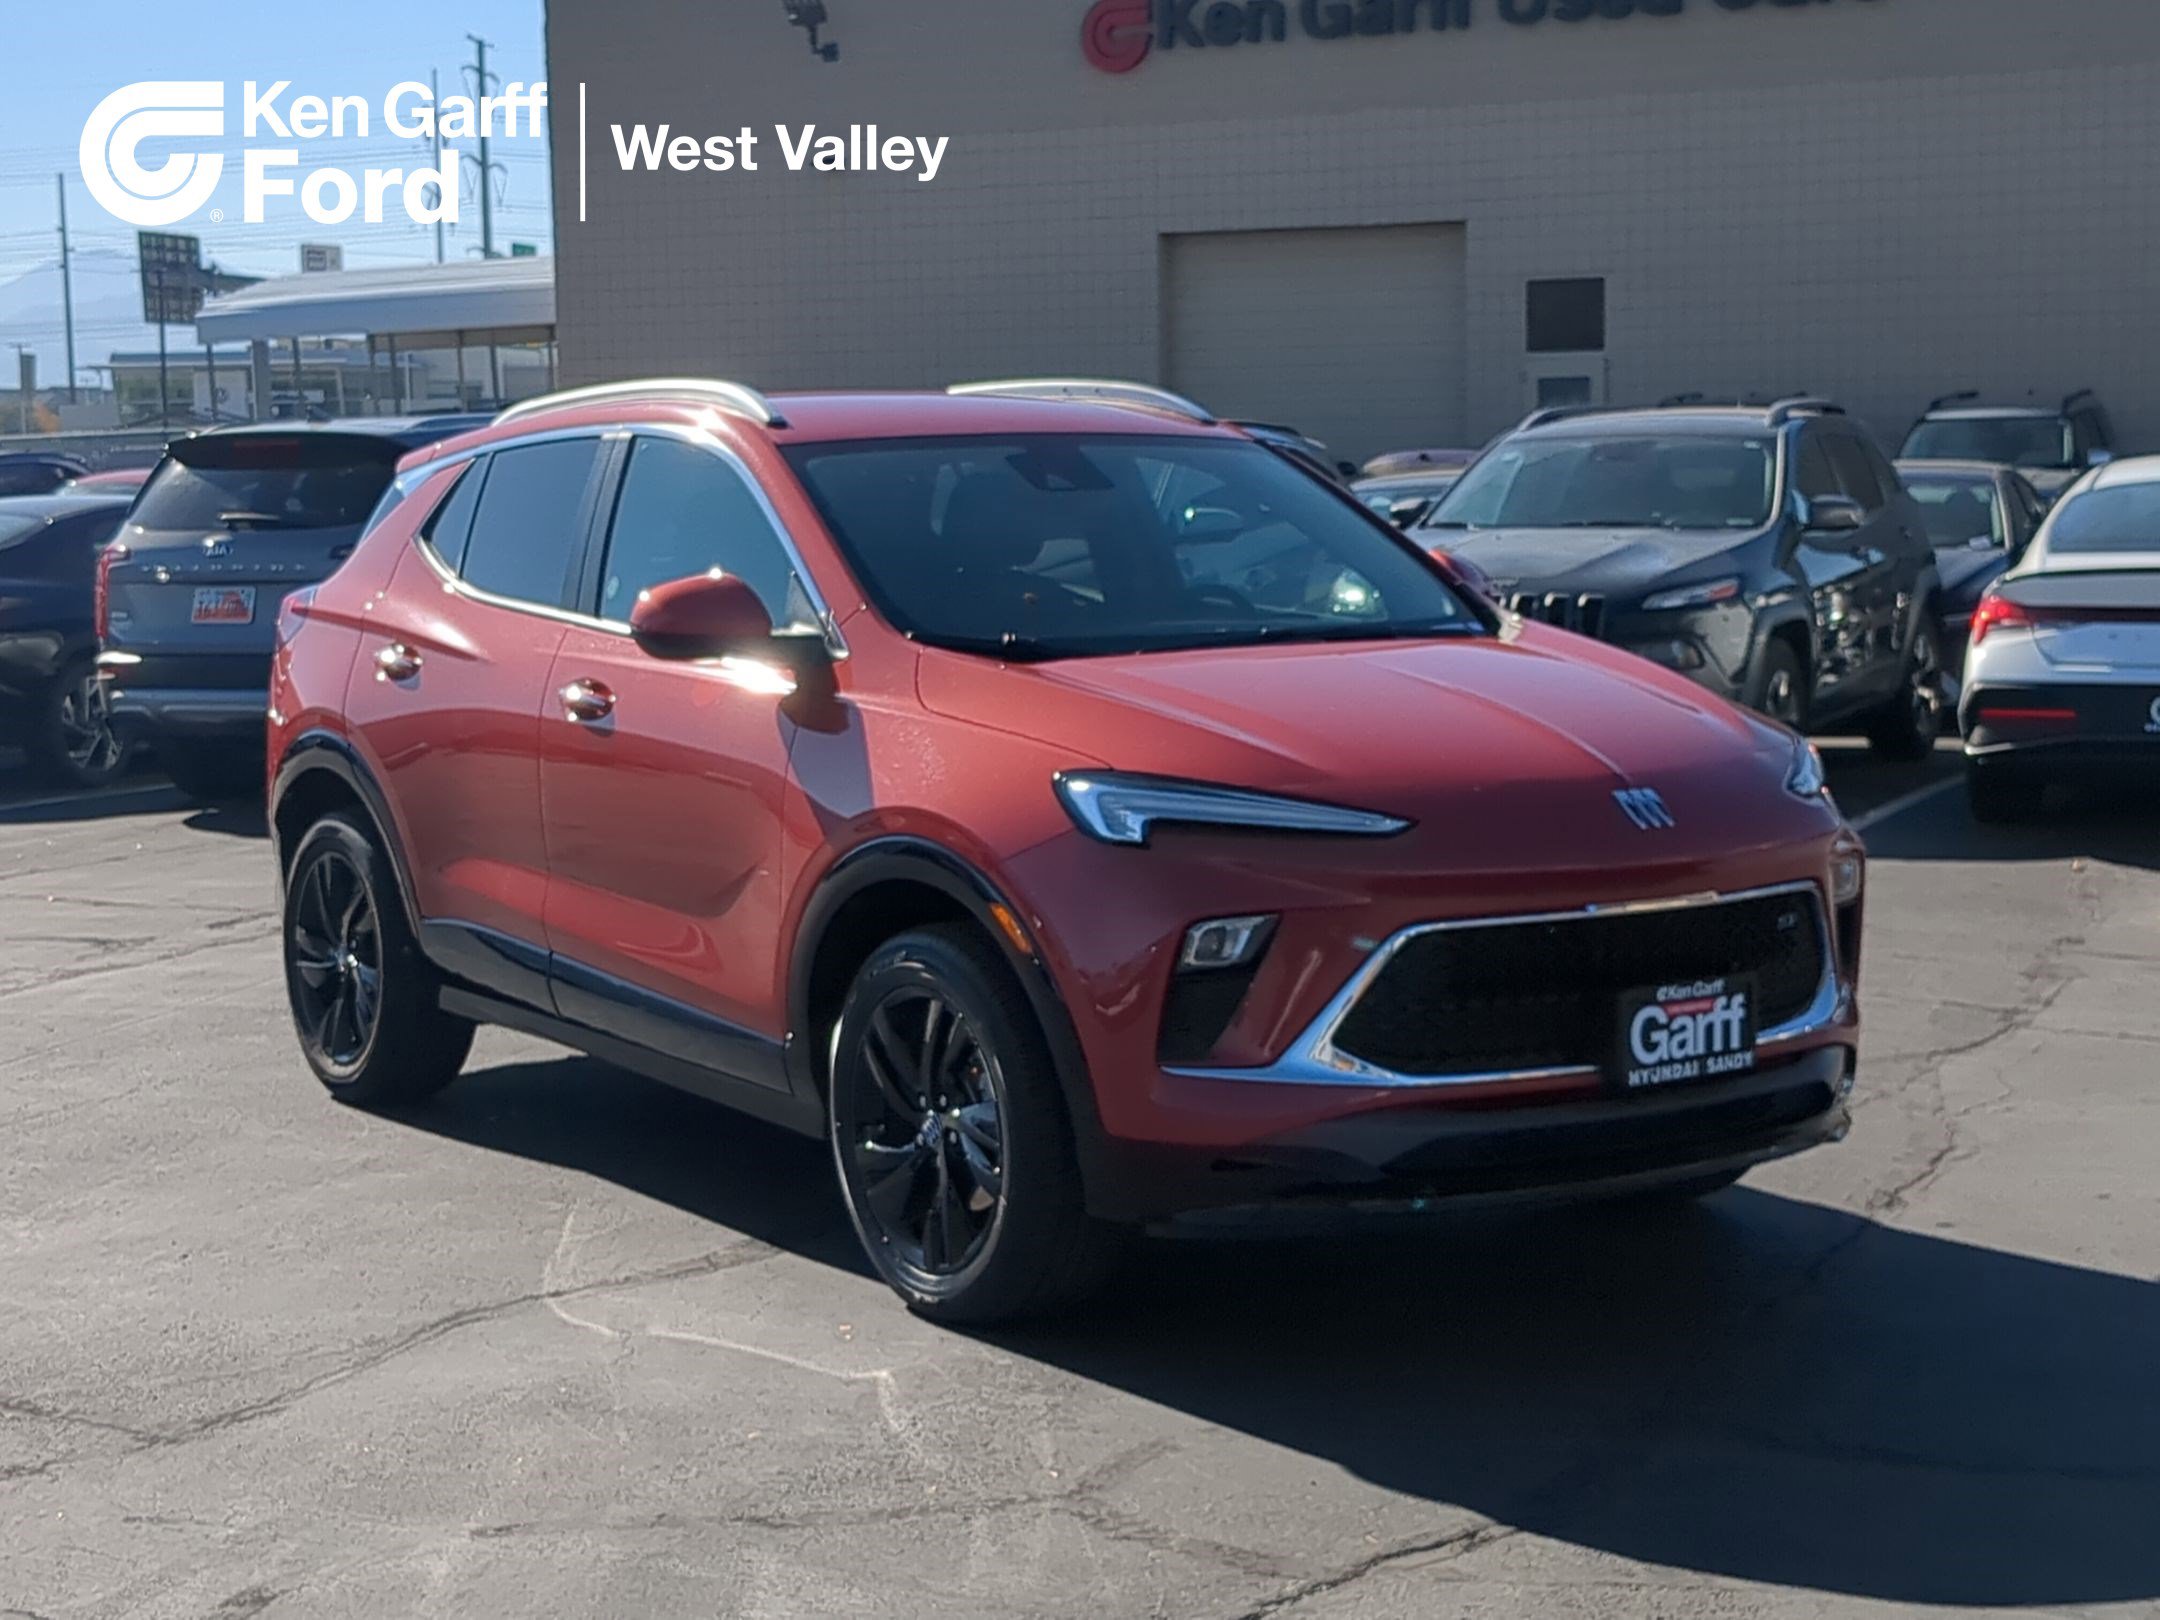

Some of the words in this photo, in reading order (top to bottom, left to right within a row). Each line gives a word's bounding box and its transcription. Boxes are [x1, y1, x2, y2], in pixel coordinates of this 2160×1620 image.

[1155, 0, 1288, 49] Ken
[1629, 993, 1747, 1065] Garff
[1628, 1060, 1700, 1087] HYUNDAI
[1706, 1051, 1754, 1074] SANDY
